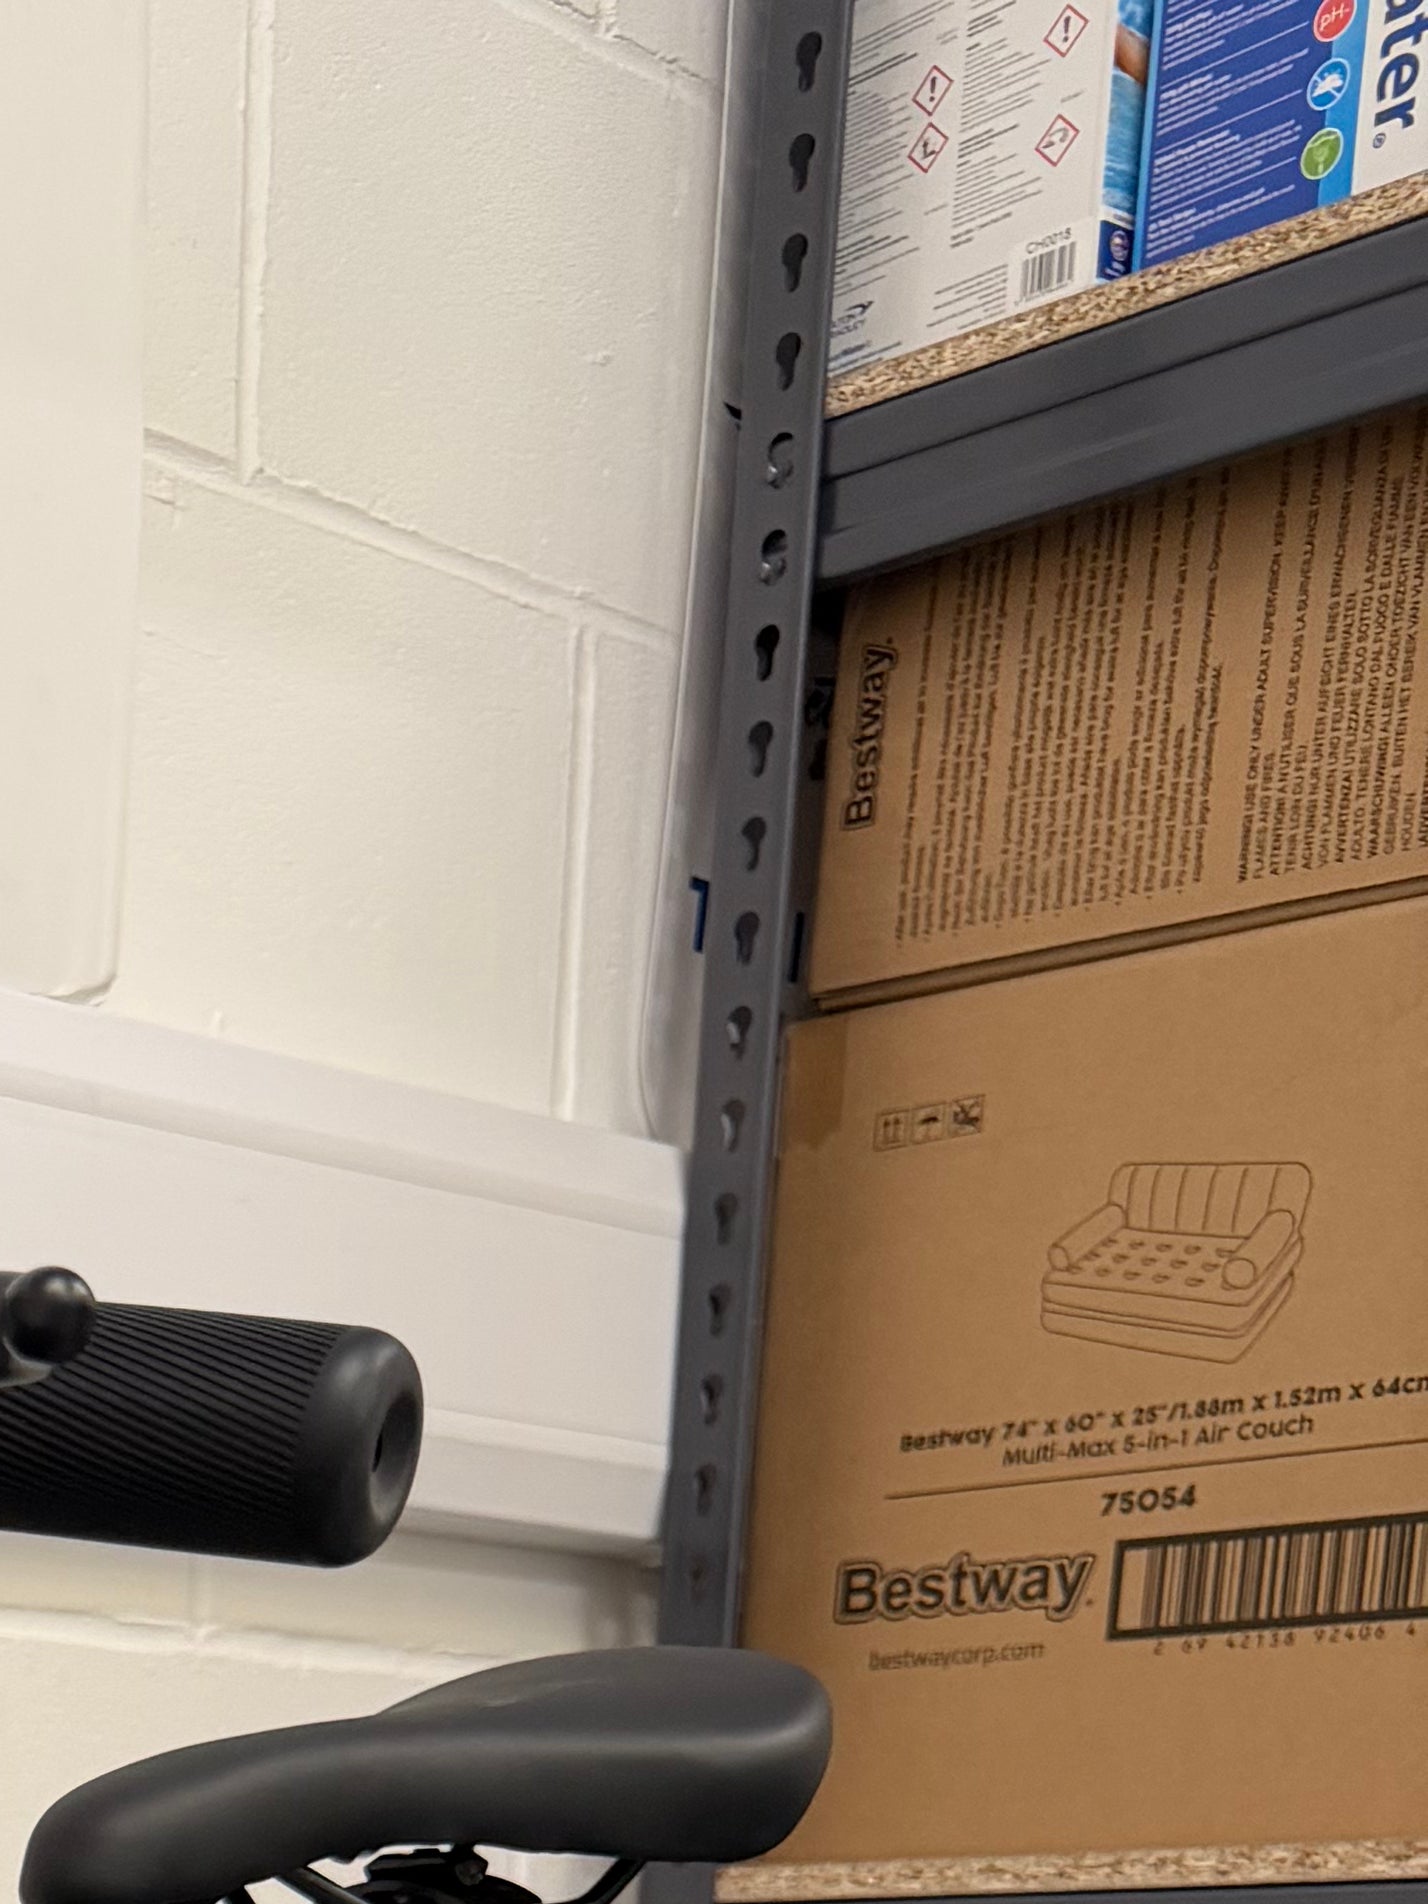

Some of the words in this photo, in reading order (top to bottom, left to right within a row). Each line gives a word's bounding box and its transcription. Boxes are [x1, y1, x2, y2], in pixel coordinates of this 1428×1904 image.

[844, 645, 894, 830] Bestway
[1196, 1423, 1230, 1445] Air
[1237, 1413, 1314, 1441] Couch
[1100, 1484, 1197, 1516] 75054
[836, 1553, 1094, 1622] Bestway
